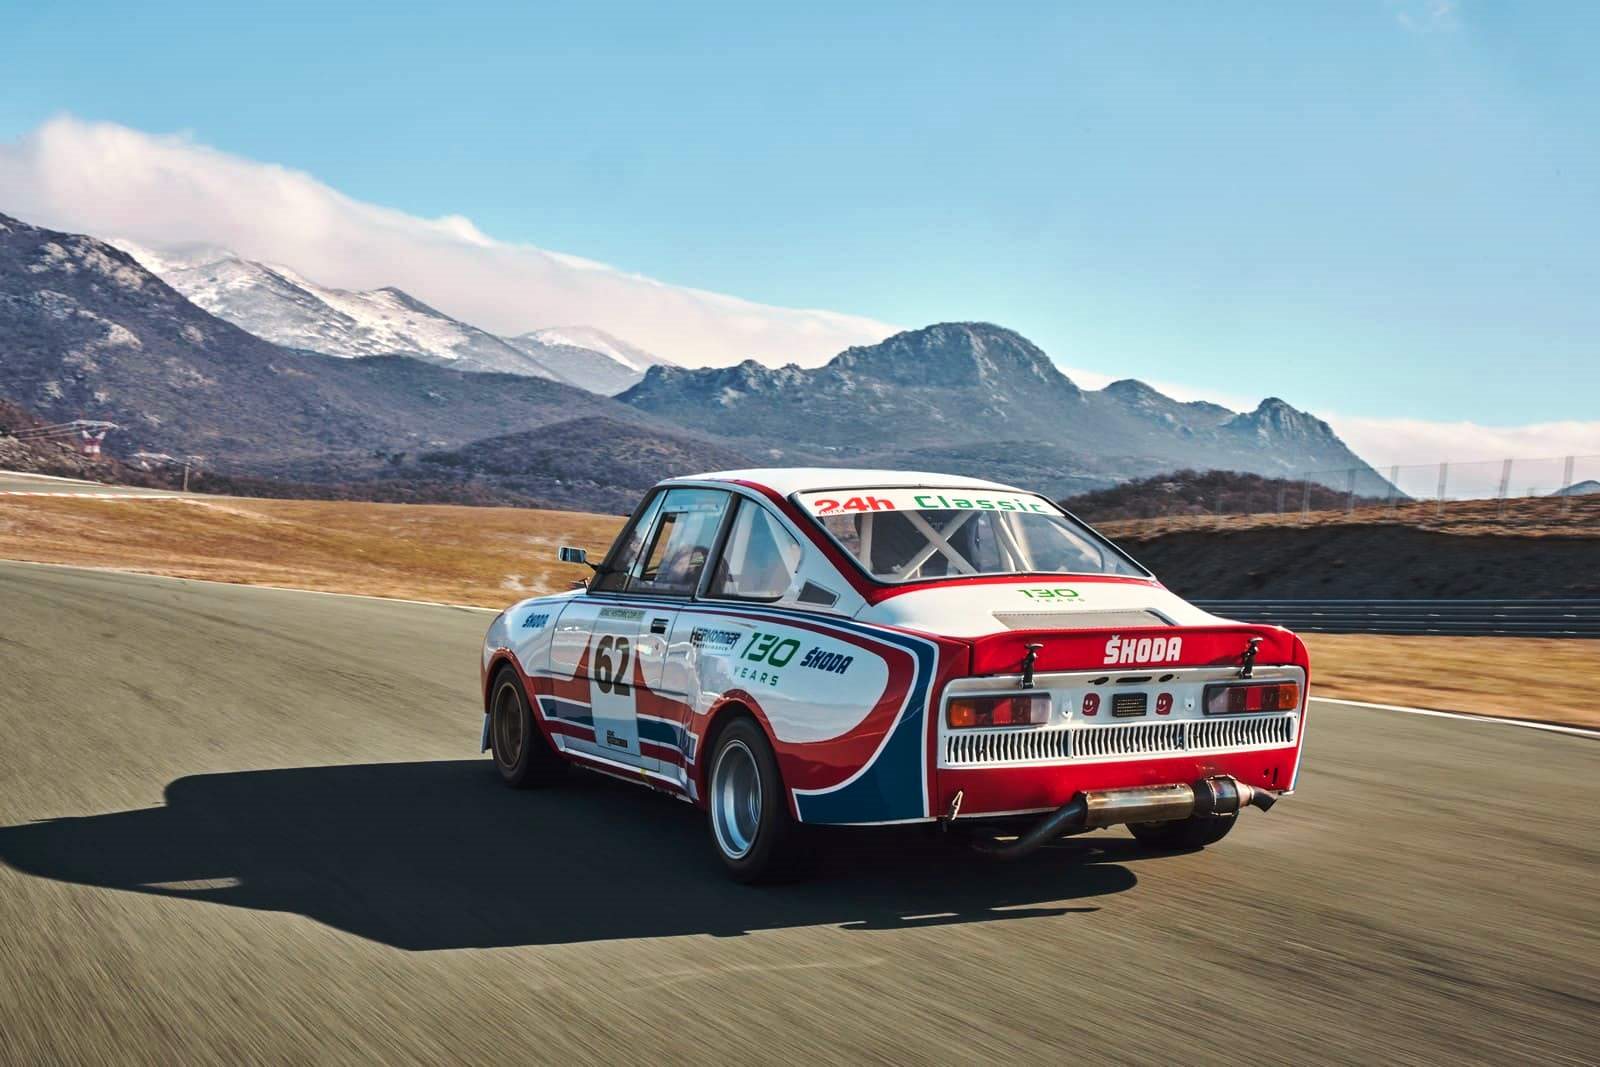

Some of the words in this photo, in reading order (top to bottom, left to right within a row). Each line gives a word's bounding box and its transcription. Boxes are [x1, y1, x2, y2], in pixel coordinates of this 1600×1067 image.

[815, 496, 896, 513] 24h
[914, 495, 1048, 513] Classic
[1016, 589, 1079, 598] 130
[740, 632, 801, 668] 130
[800, 647, 854, 675] ŠKODA
[1103, 634, 1182, 665] ŠKODA
[594, 635, 630, 696] 62
[734, 665, 779, 686] YEARS
